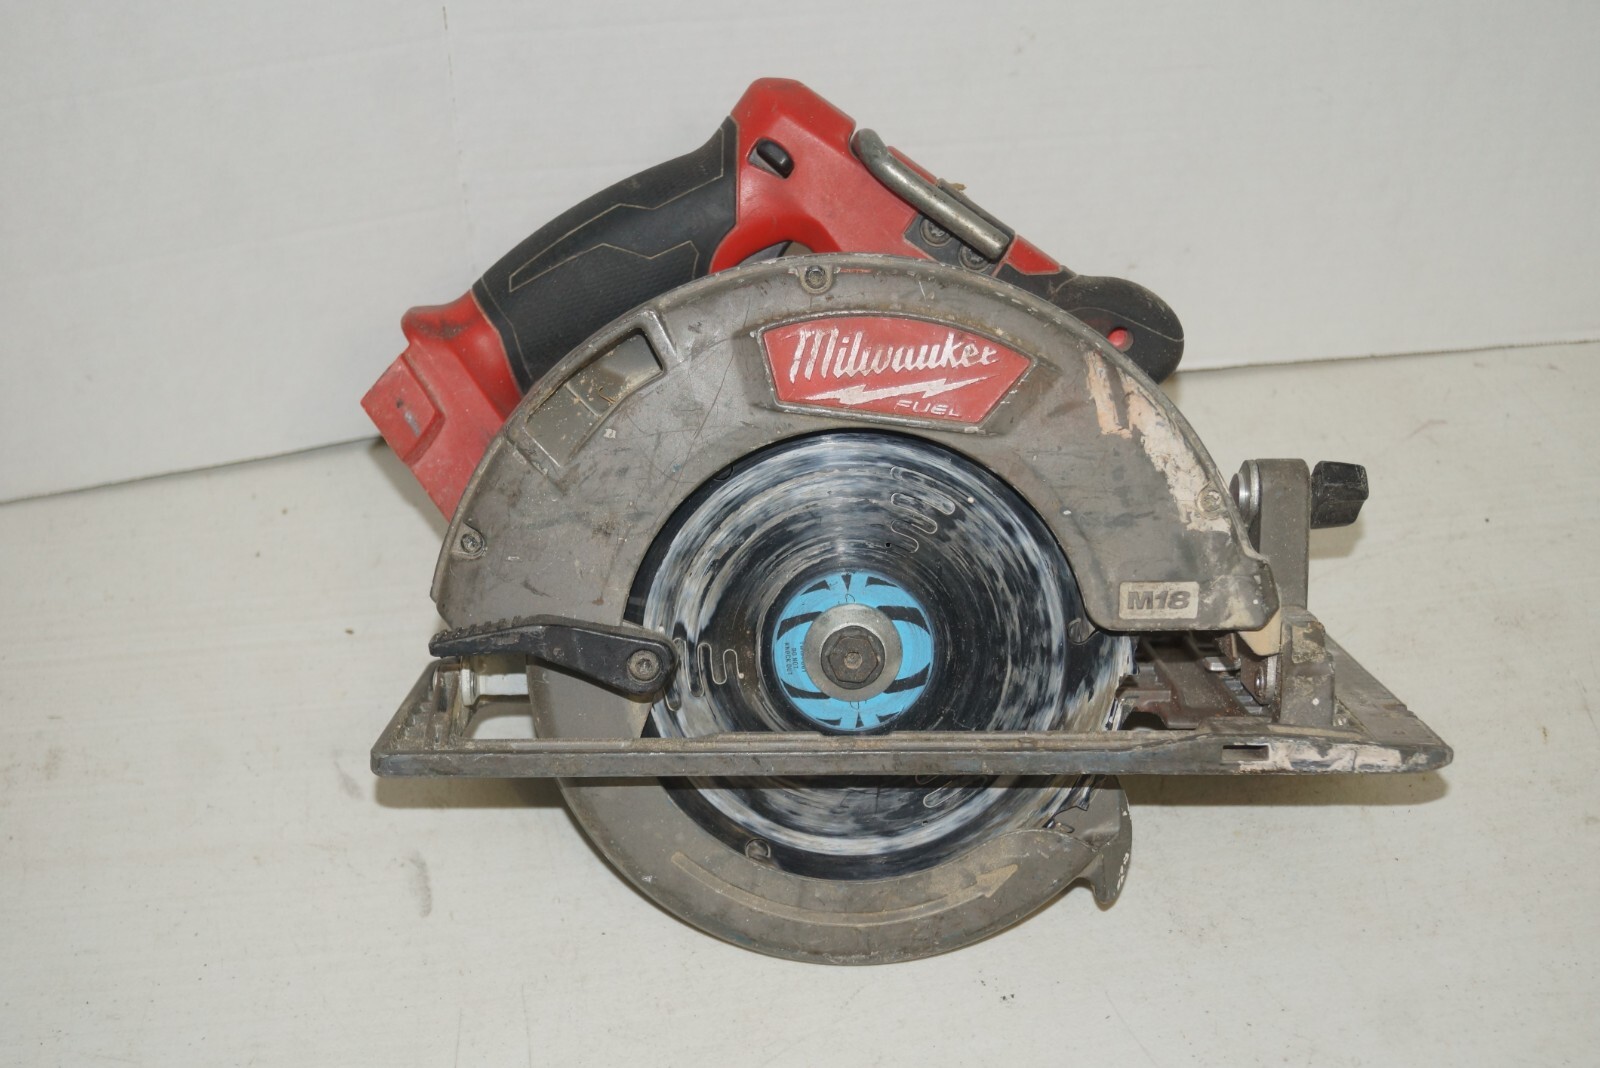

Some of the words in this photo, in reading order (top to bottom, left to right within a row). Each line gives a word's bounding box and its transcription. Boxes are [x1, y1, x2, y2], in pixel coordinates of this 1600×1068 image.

[781, 328, 999, 384] Milwaukee
[894, 399, 962, 418] FUEL
[1127, 591, 1191, 609] M18
[791, 648, 797, 656] DO
